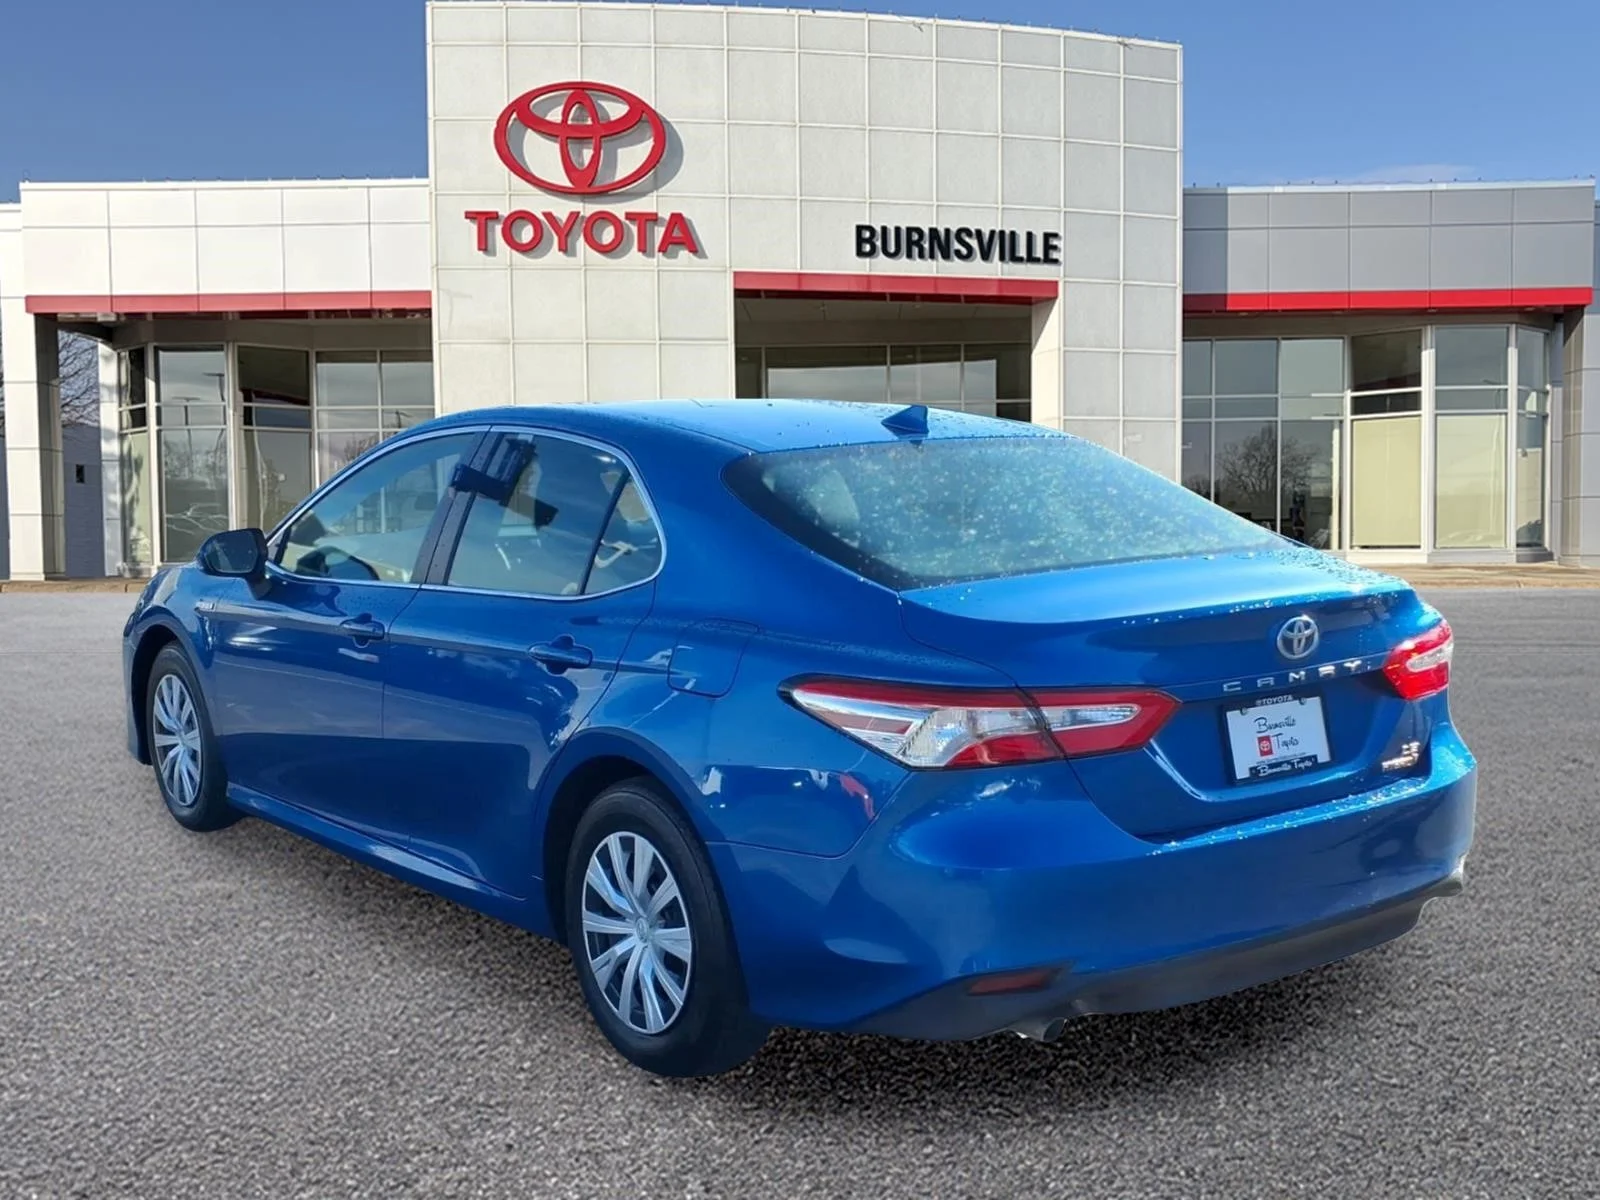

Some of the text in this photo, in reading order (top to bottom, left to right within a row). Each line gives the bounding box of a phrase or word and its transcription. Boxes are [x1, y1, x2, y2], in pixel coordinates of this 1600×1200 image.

[465, 210, 699, 254] TOYOTA
[855, 224, 1061, 264] BURNSVILLE
[1222, 659, 1362, 692] CAMRY
[1263, 694, 1293, 705] TOYOTA
